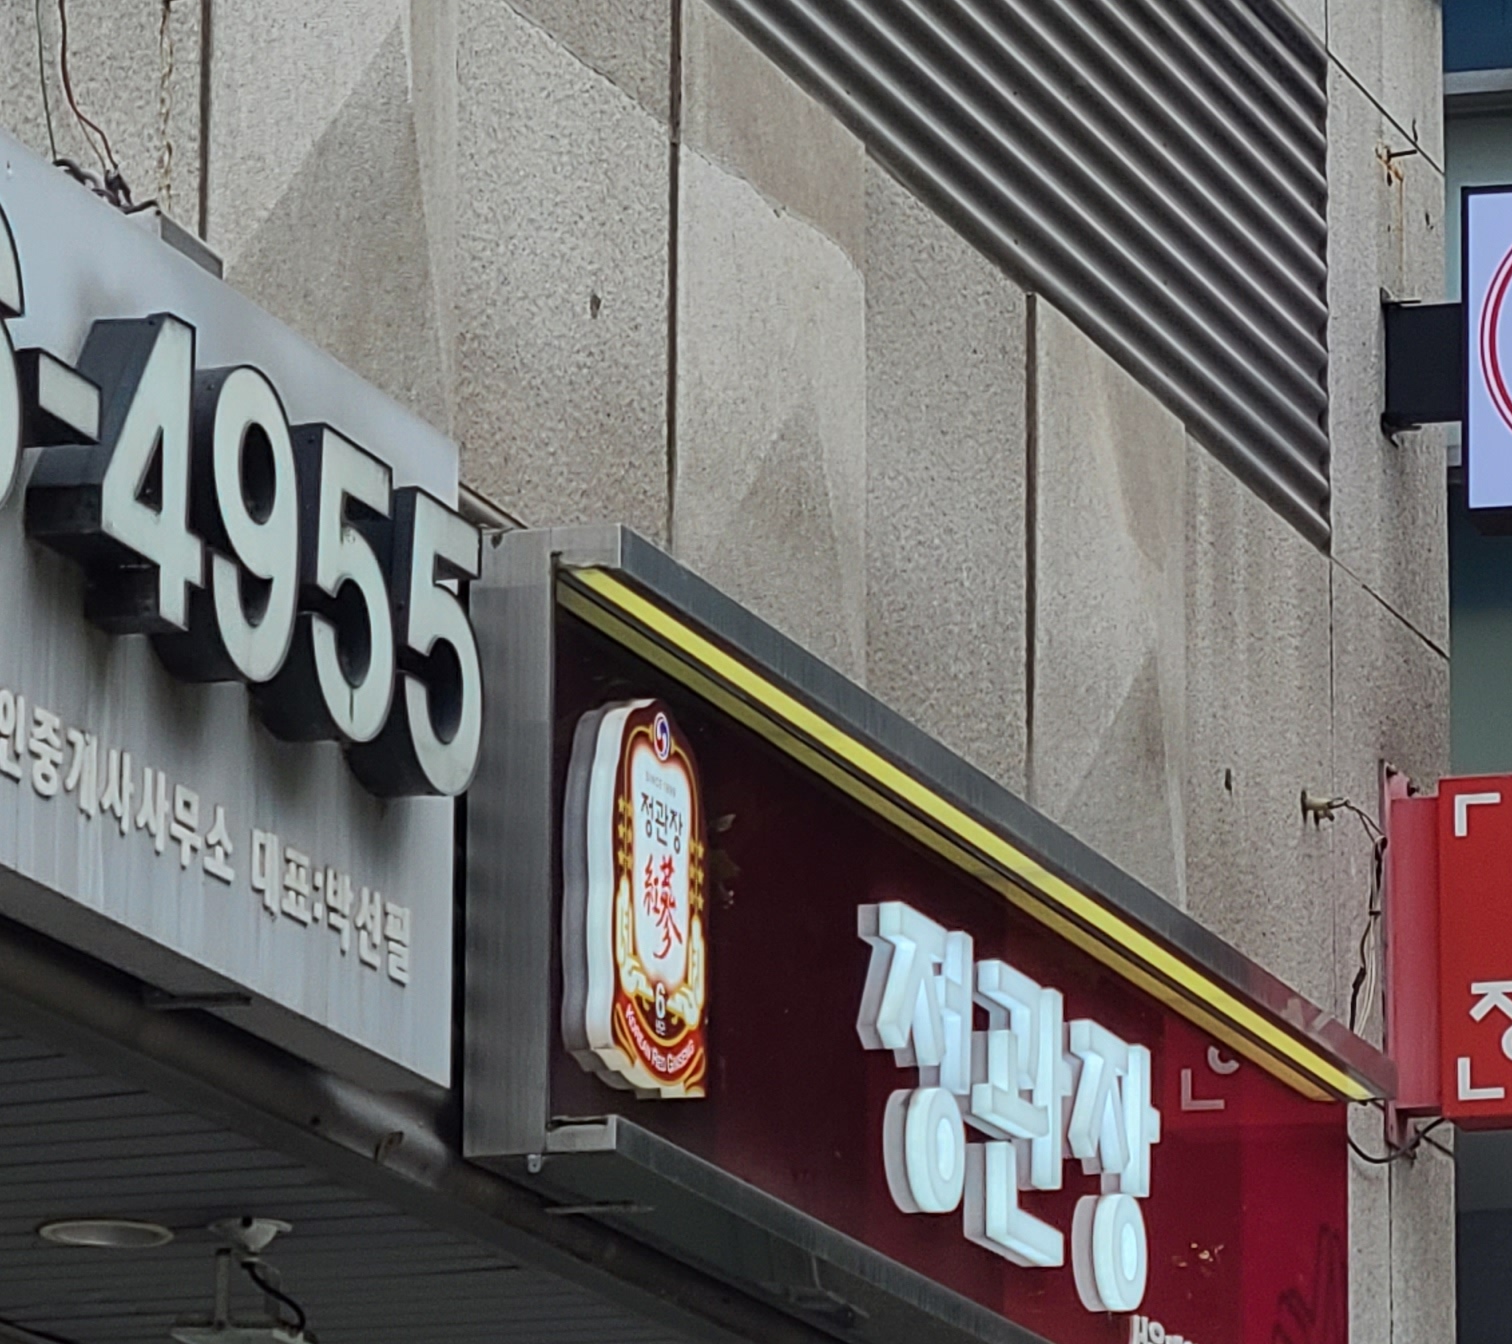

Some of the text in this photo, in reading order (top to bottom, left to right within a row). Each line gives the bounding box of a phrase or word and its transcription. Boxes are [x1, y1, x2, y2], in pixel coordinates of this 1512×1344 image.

[0, 201, 483, 798] -4955
[640, 792, 683, 854] 정관장
[857, 901, 1161, 1312] 정관장
